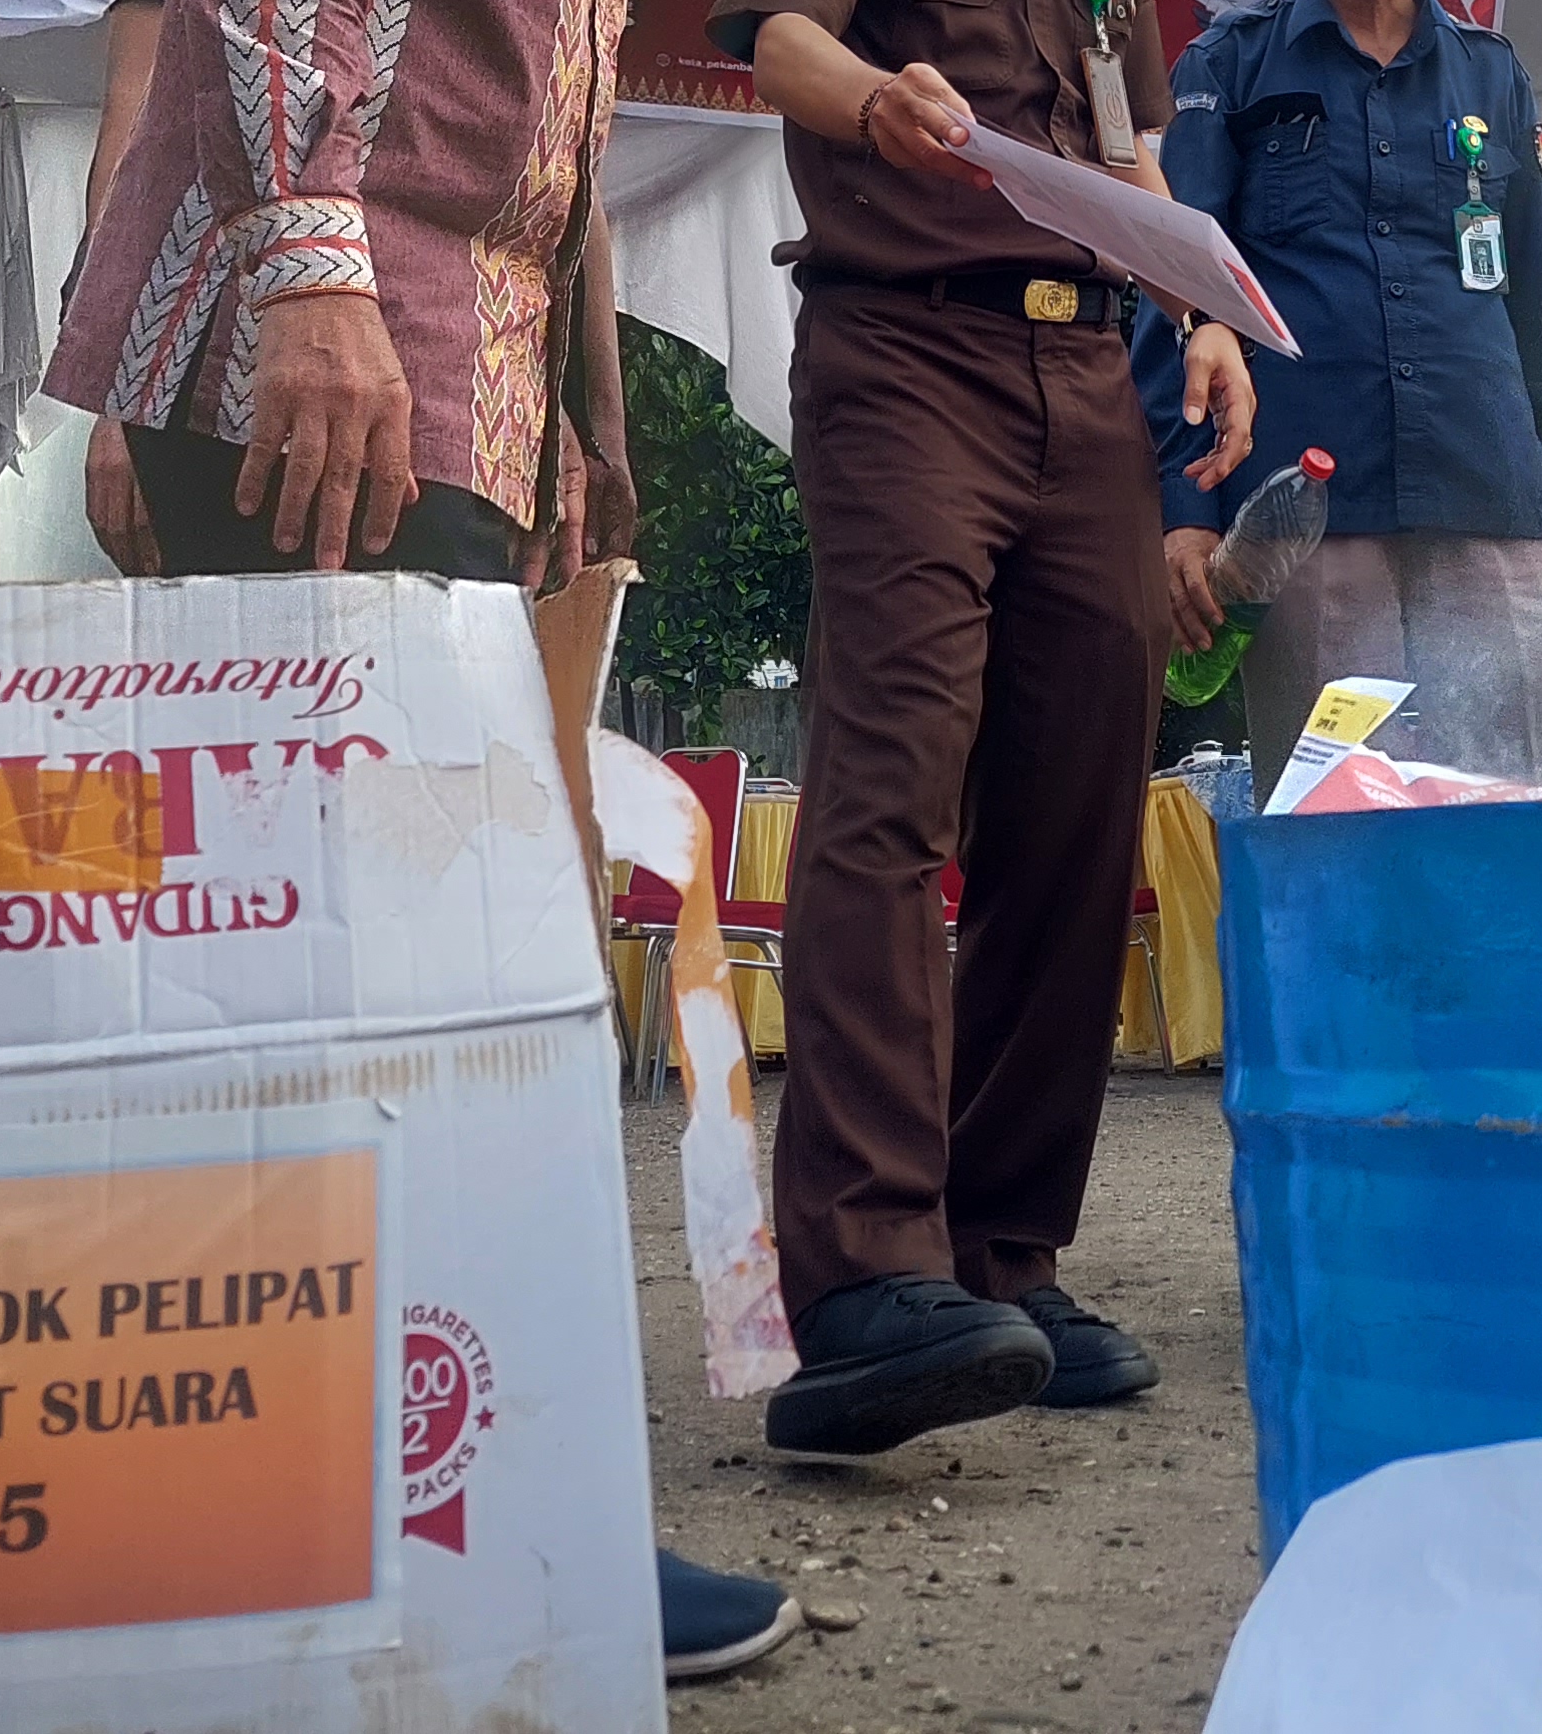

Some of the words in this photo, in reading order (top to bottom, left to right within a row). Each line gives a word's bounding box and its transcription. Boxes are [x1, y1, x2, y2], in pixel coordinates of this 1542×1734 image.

[98, 1261, 363, 1337] PELIPAT
[40, 1368, 258, 1436] SUARA
[407, 1441, 477, 1504] PACKS
